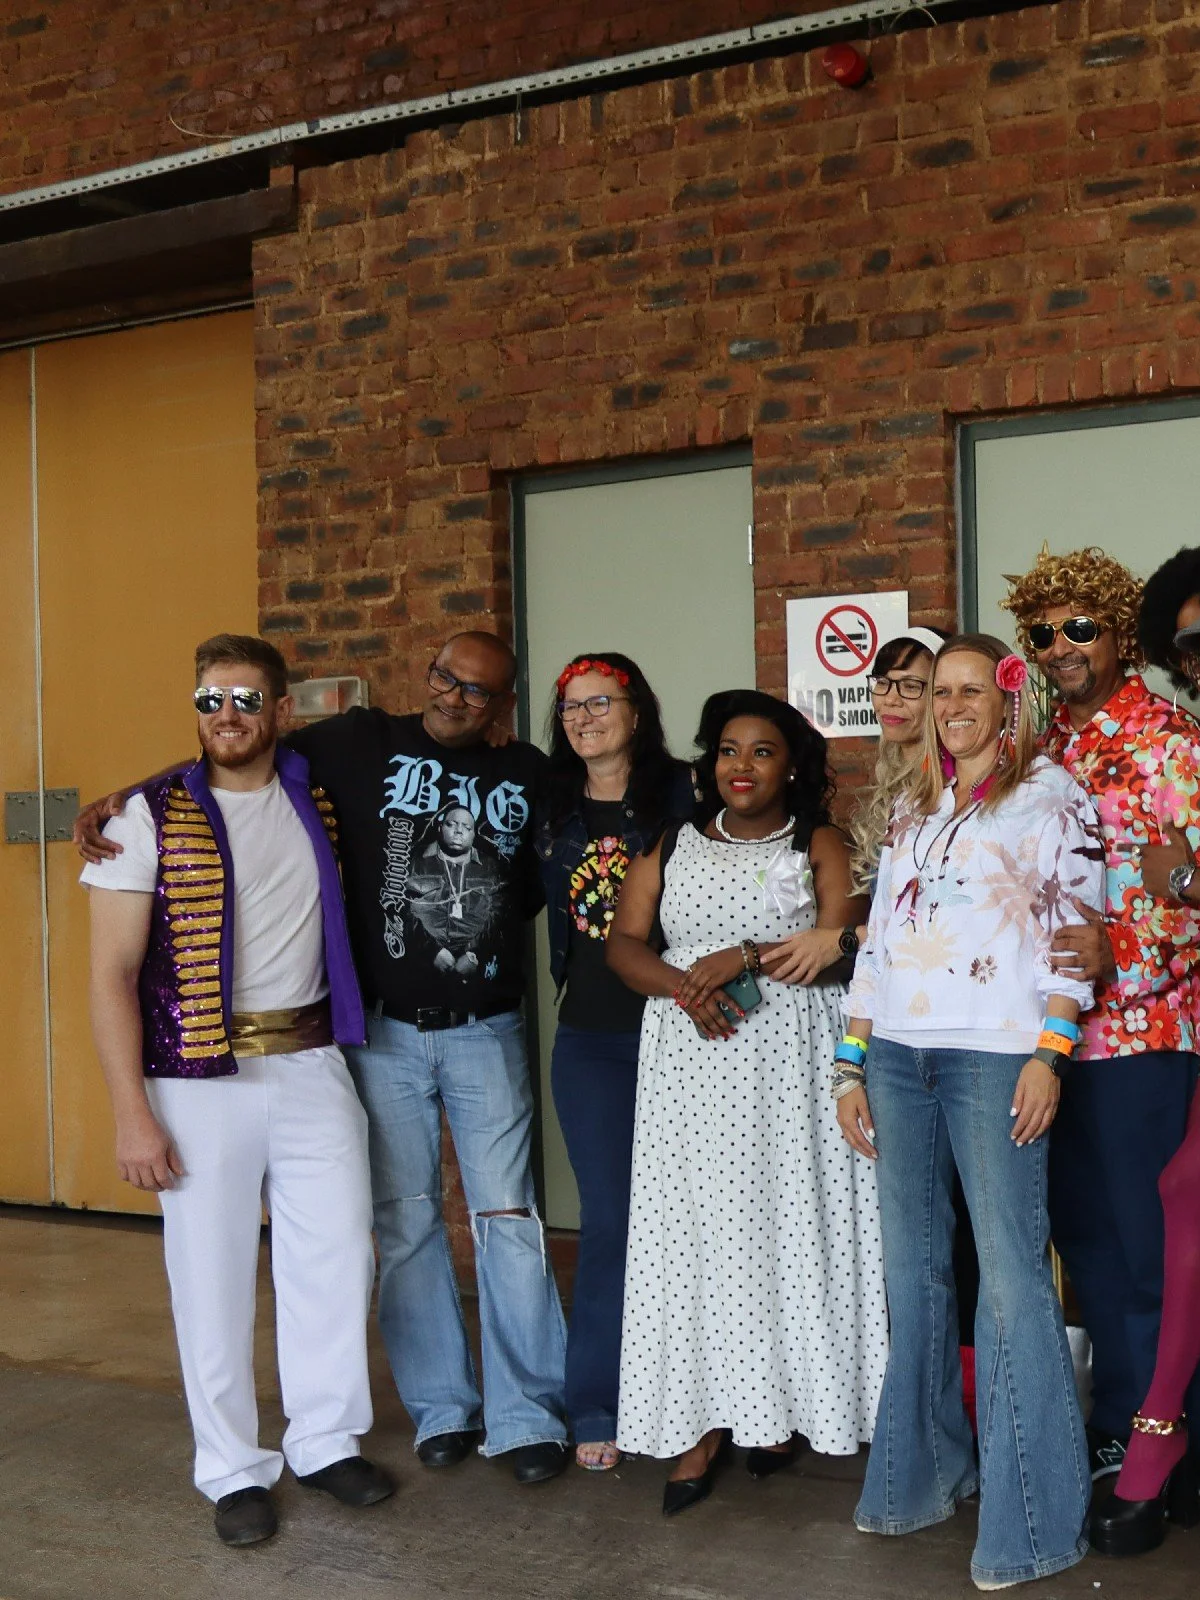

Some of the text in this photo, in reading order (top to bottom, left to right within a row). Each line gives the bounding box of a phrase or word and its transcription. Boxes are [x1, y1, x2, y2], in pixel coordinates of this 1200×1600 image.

[796, 688, 834, 728] NO
[379, 754, 529, 833] BIG
[379, 816, 415, 913] Notorious
